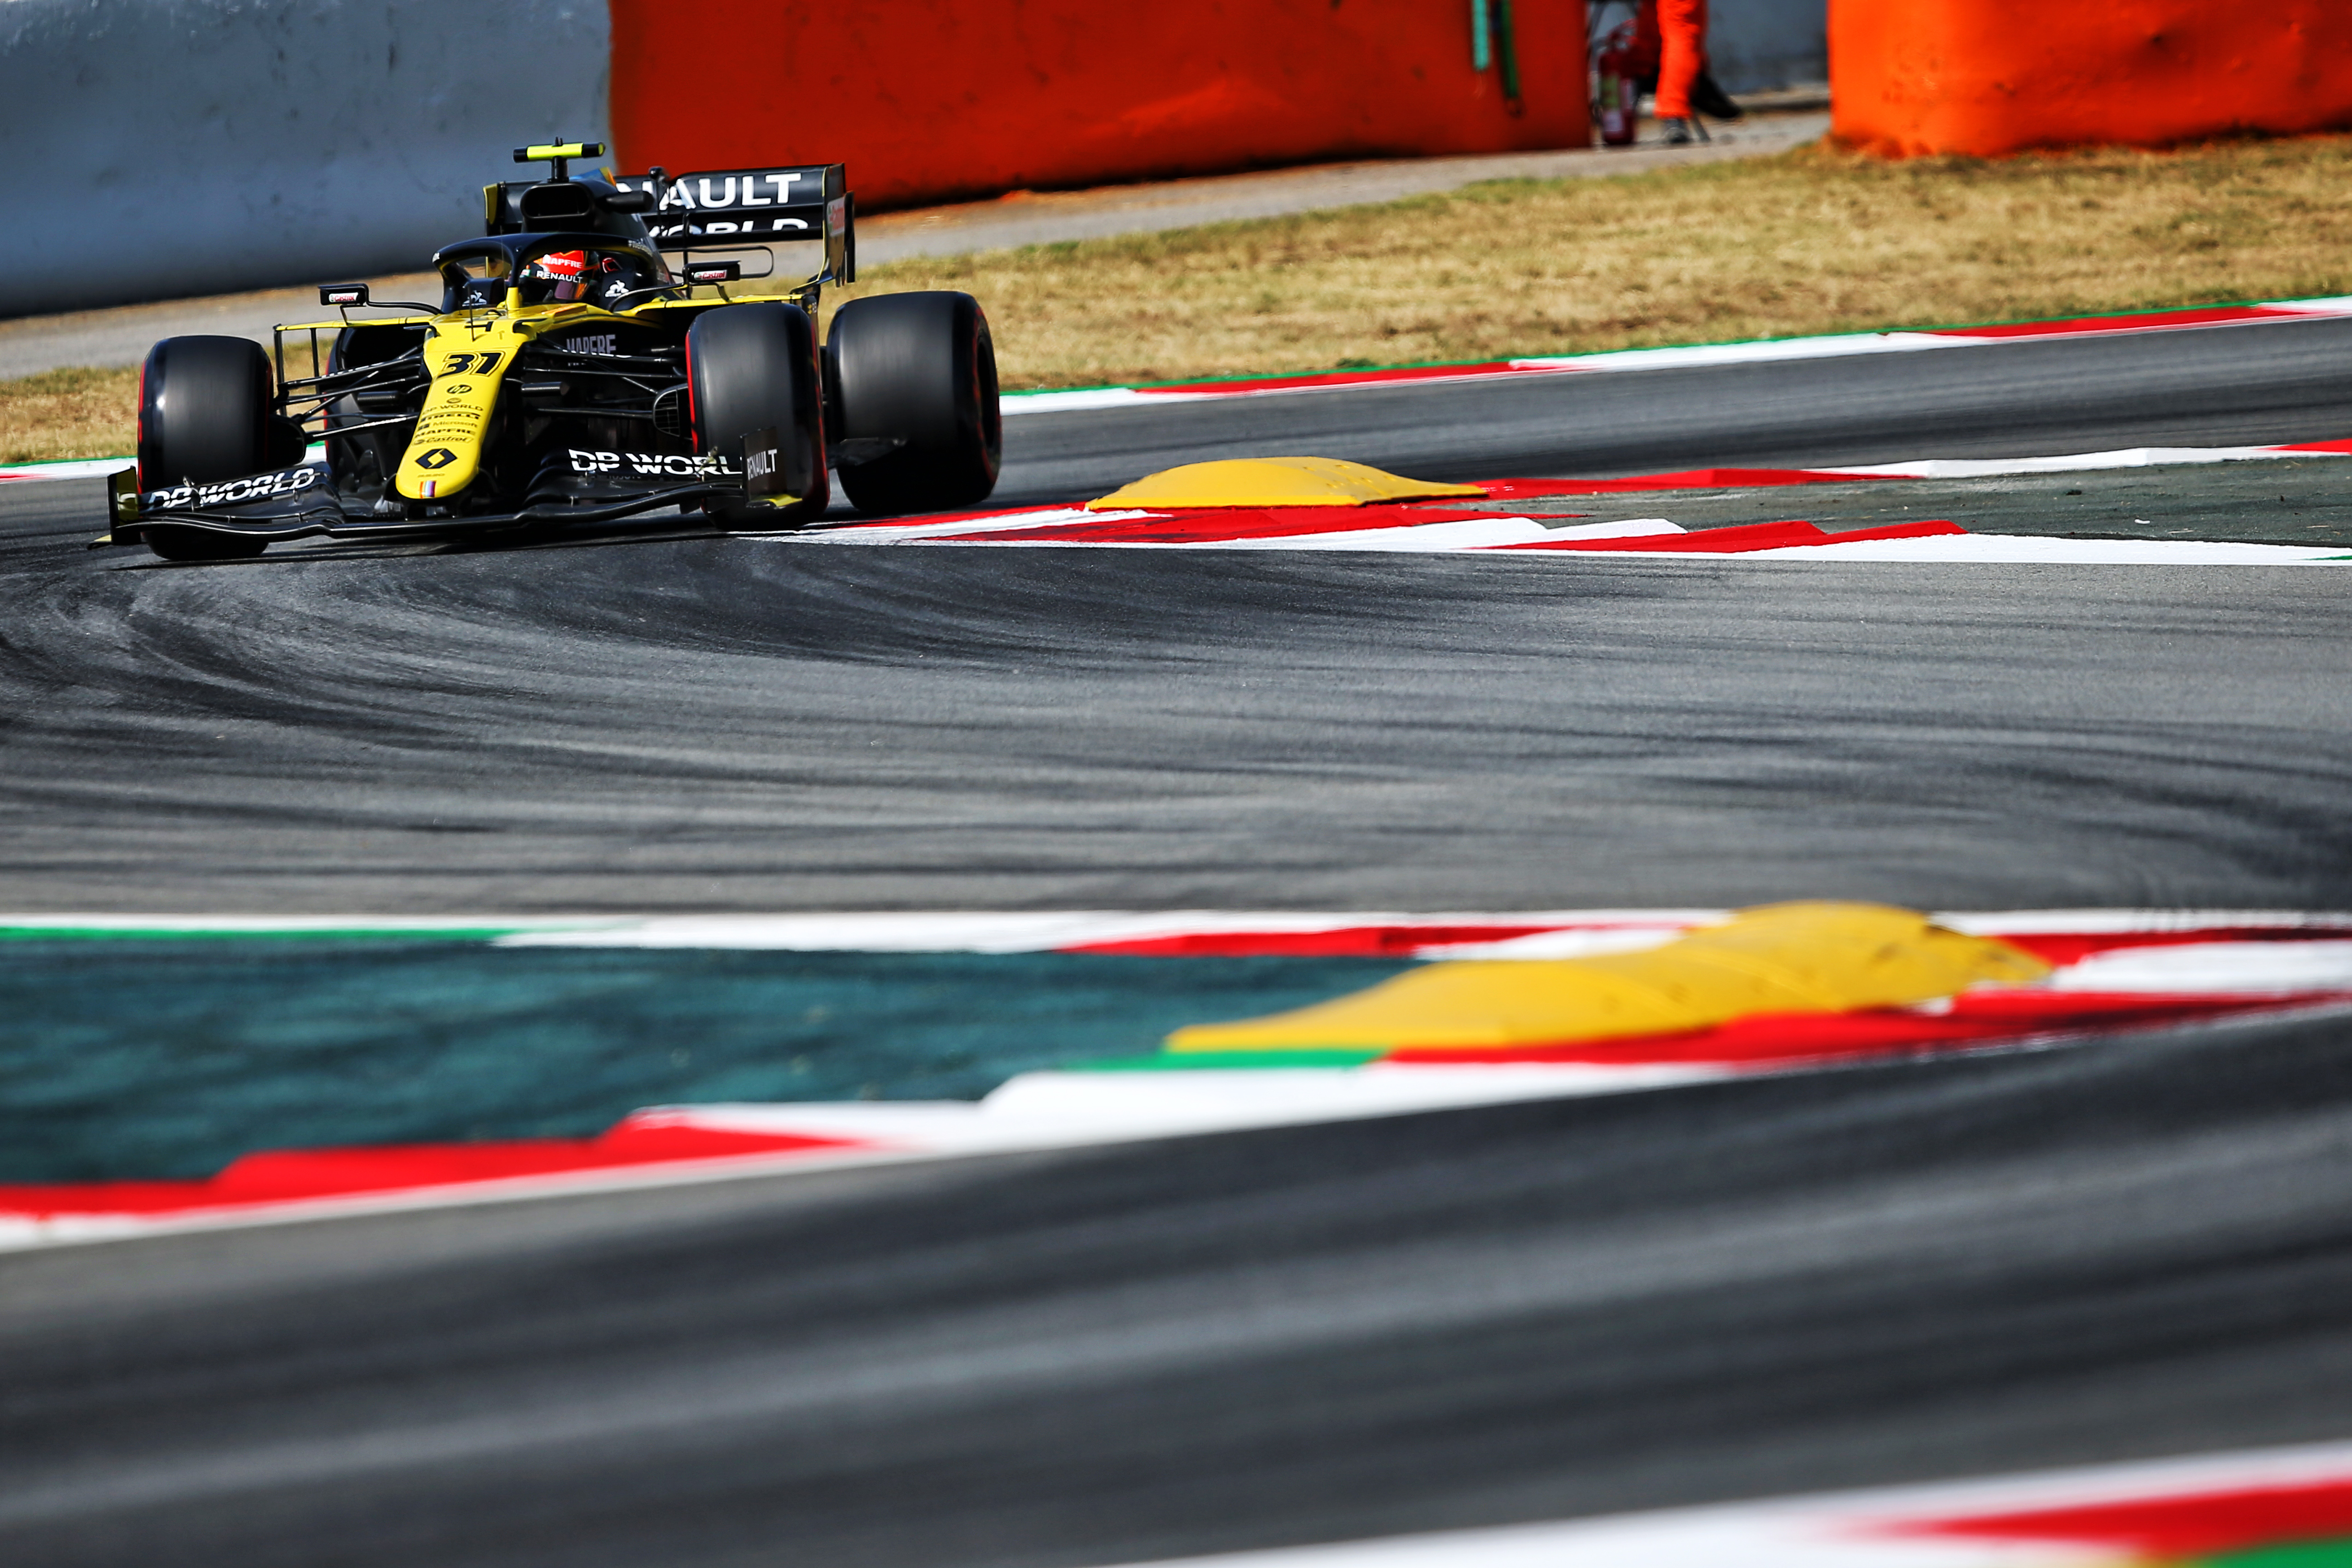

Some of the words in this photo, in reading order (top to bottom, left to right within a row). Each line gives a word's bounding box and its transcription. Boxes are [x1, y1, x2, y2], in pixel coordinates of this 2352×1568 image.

[536, 270, 583, 283] RENAULT
[702, 271, 725, 279] Castrol
[438, 351, 505, 379] 31
[415, 429, 476, 438] MAPFRE
[568, 449, 620, 472] DP
[625, 453, 743, 475] WORL
[747, 449, 777, 480] RENAULT
[148, 486, 192, 508] DP
[198, 468, 316, 505] WORLD
